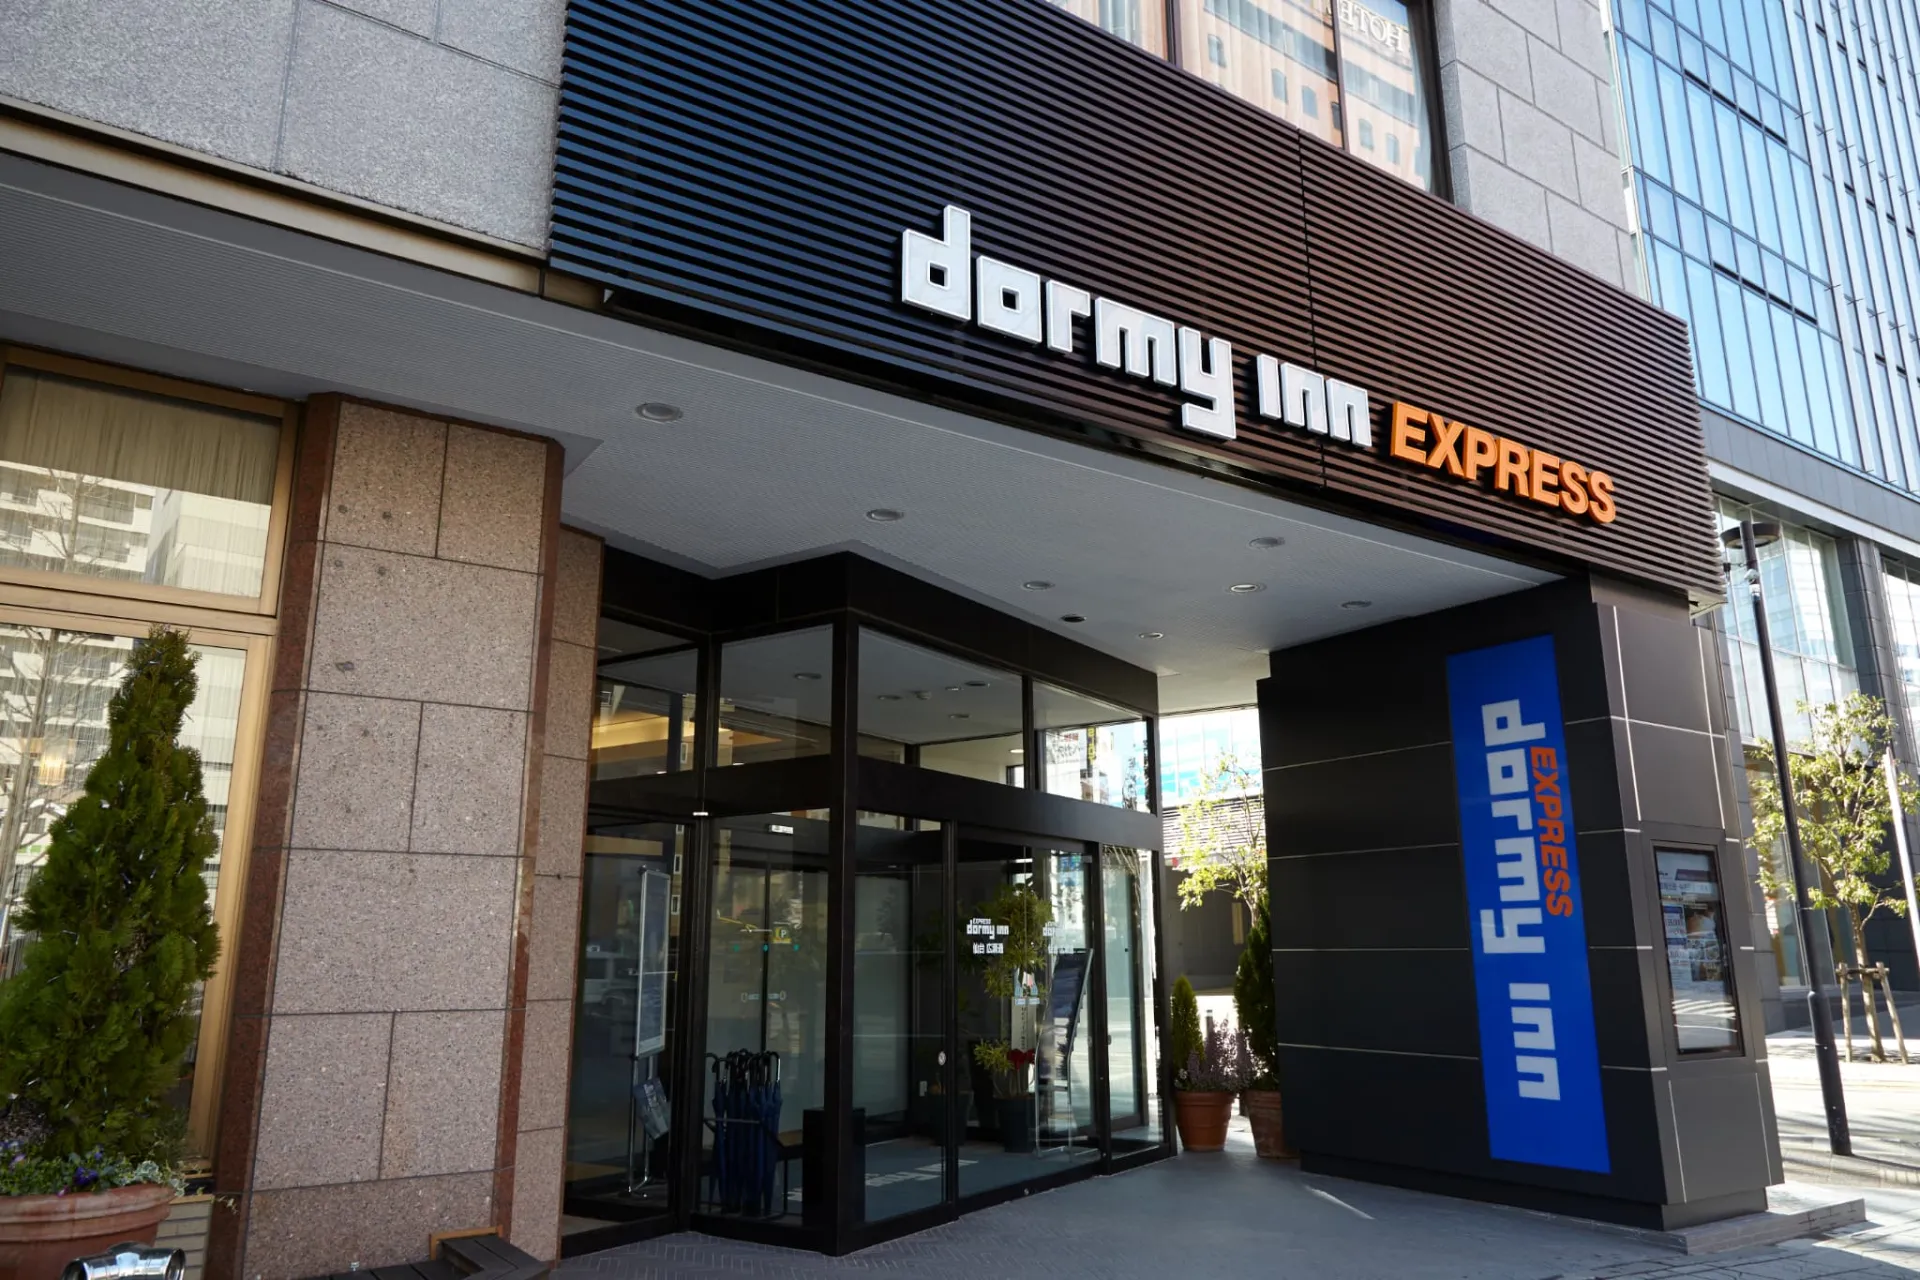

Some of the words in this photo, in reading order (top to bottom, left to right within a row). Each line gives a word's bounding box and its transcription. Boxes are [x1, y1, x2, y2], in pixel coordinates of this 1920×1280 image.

[902, 205, 1236, 440] dormy
[1257, 353, 1372, 448] inn
[1390, 401, 1616, 523] EXPRESS
[1480, 699, 1546, 954] dormy
[1530, 745, 1573, 917] EXPRESS
[966, 919, 995, 940] dormy
[1508, 982, 1560, 1100] inn
